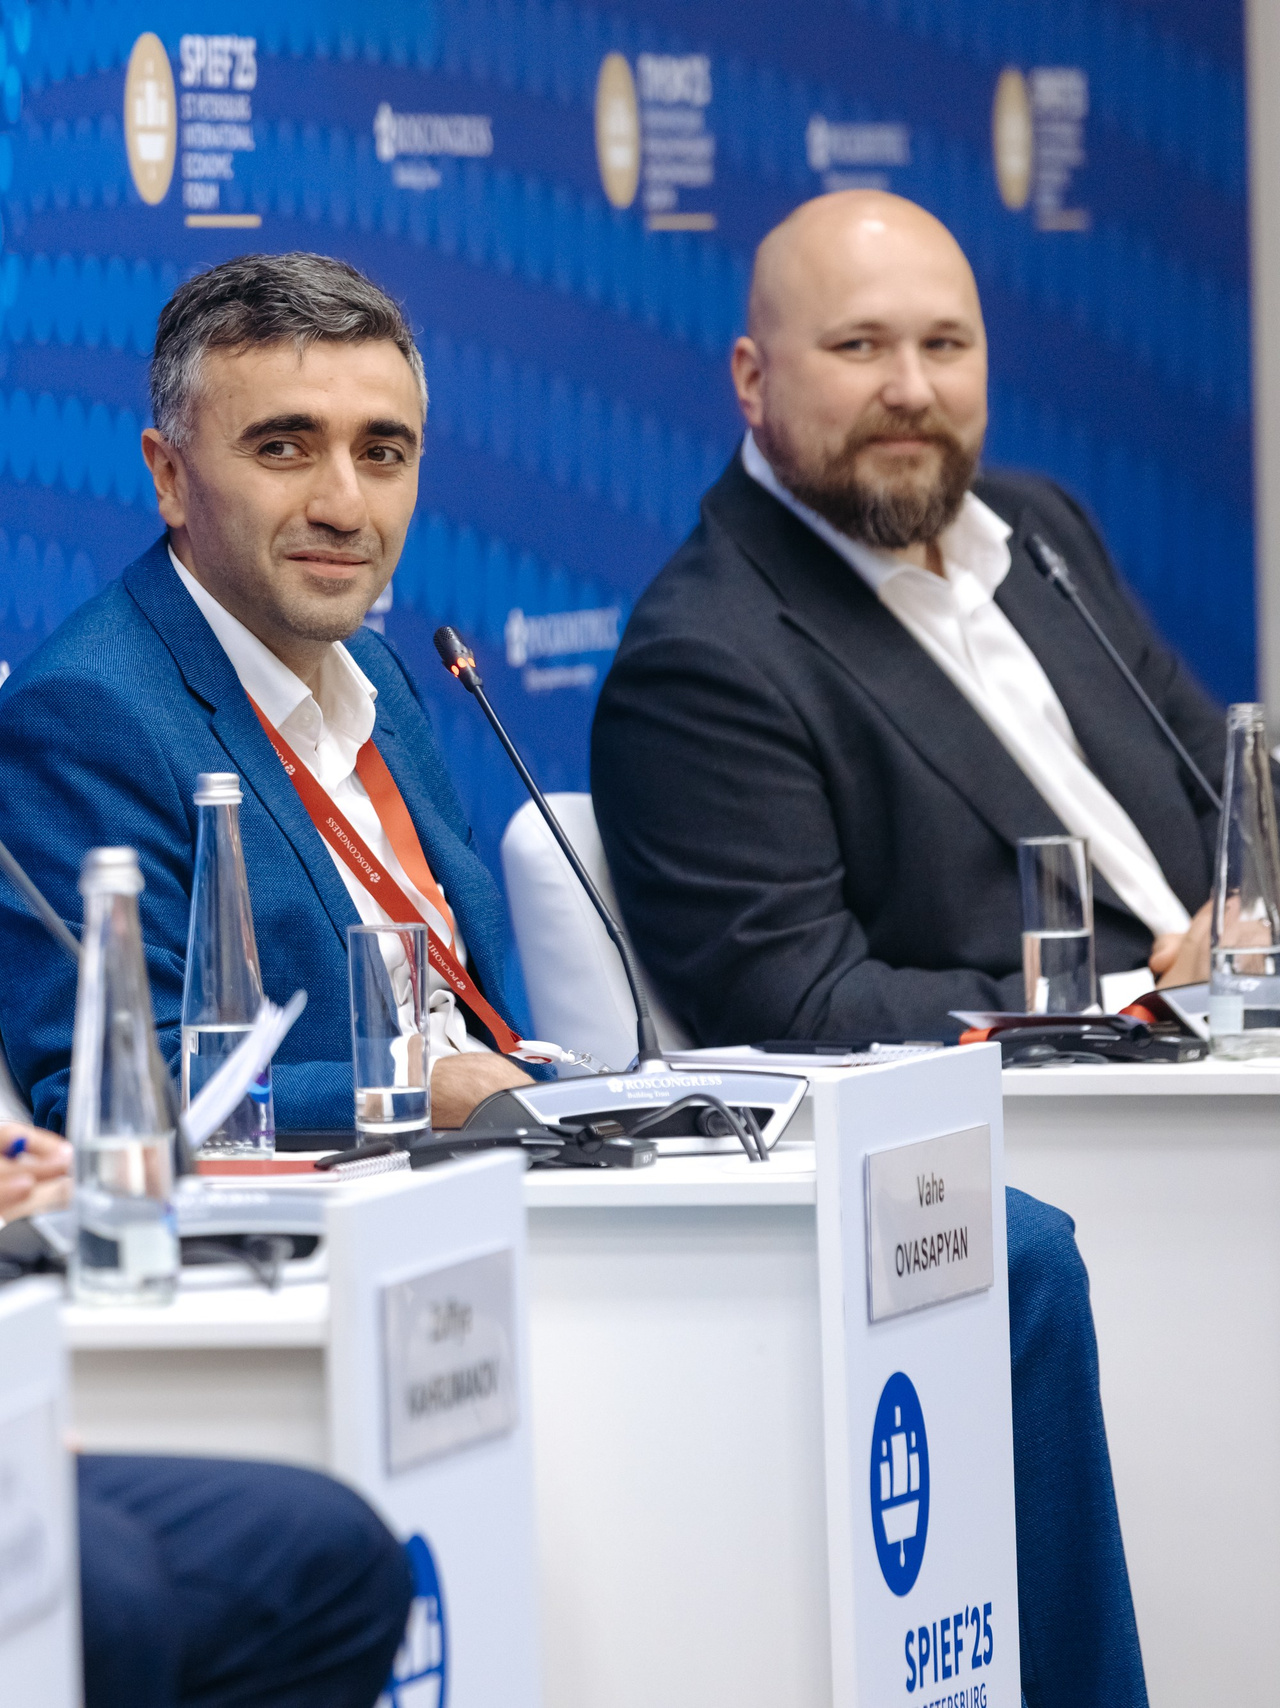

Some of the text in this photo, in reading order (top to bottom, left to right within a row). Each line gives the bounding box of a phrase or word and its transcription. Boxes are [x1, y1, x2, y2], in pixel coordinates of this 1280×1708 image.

[325, 817, 374, 875] ROSCONGRESS
[625, 1075, 722, 1090] ROSCONGRESS
[916, 1172, 945, 1208] Vahe
[895, 1226, 969, 1278] OVASAPYAN
[923, 1682, 988, 1708] SBURG
